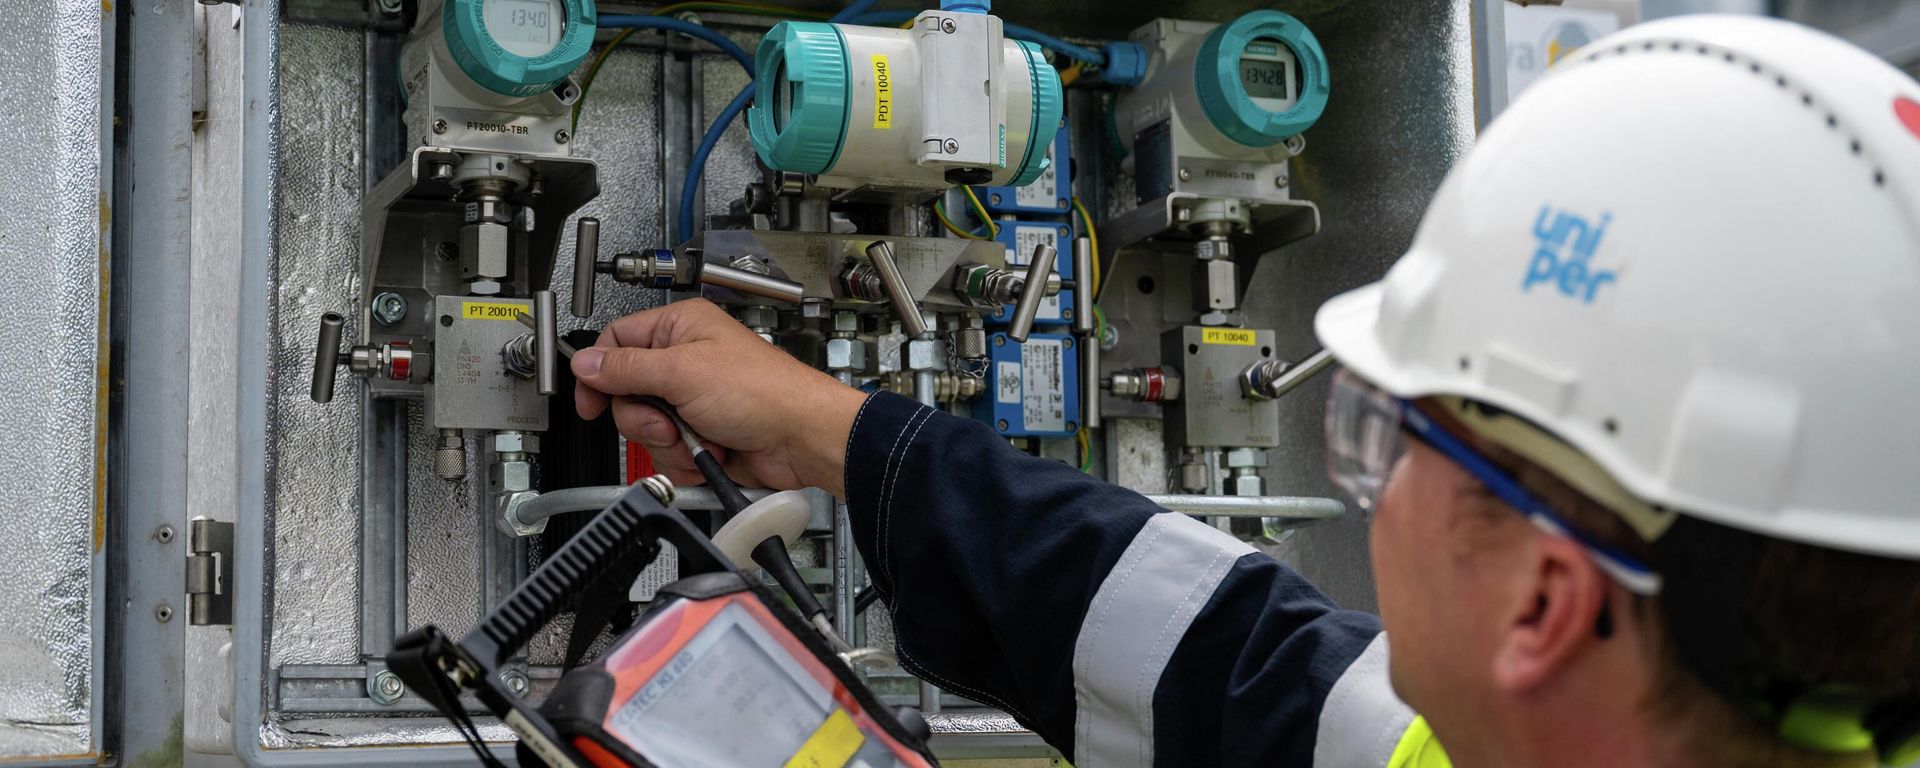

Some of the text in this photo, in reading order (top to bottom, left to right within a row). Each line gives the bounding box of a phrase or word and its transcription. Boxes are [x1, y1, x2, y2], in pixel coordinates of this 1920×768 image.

[875, 61, 889, 122] PDT 10040
[466, 121, 529, 135] PT20010-TBR
[1532, 203, 1613, 256] uni
[1520, 247, 1616, 304] per
[470, 306, 520, 318] PT 20010
[1207, 331, 1249, 343] PT 10040
[506, 416, 540, 424] PROCESS
